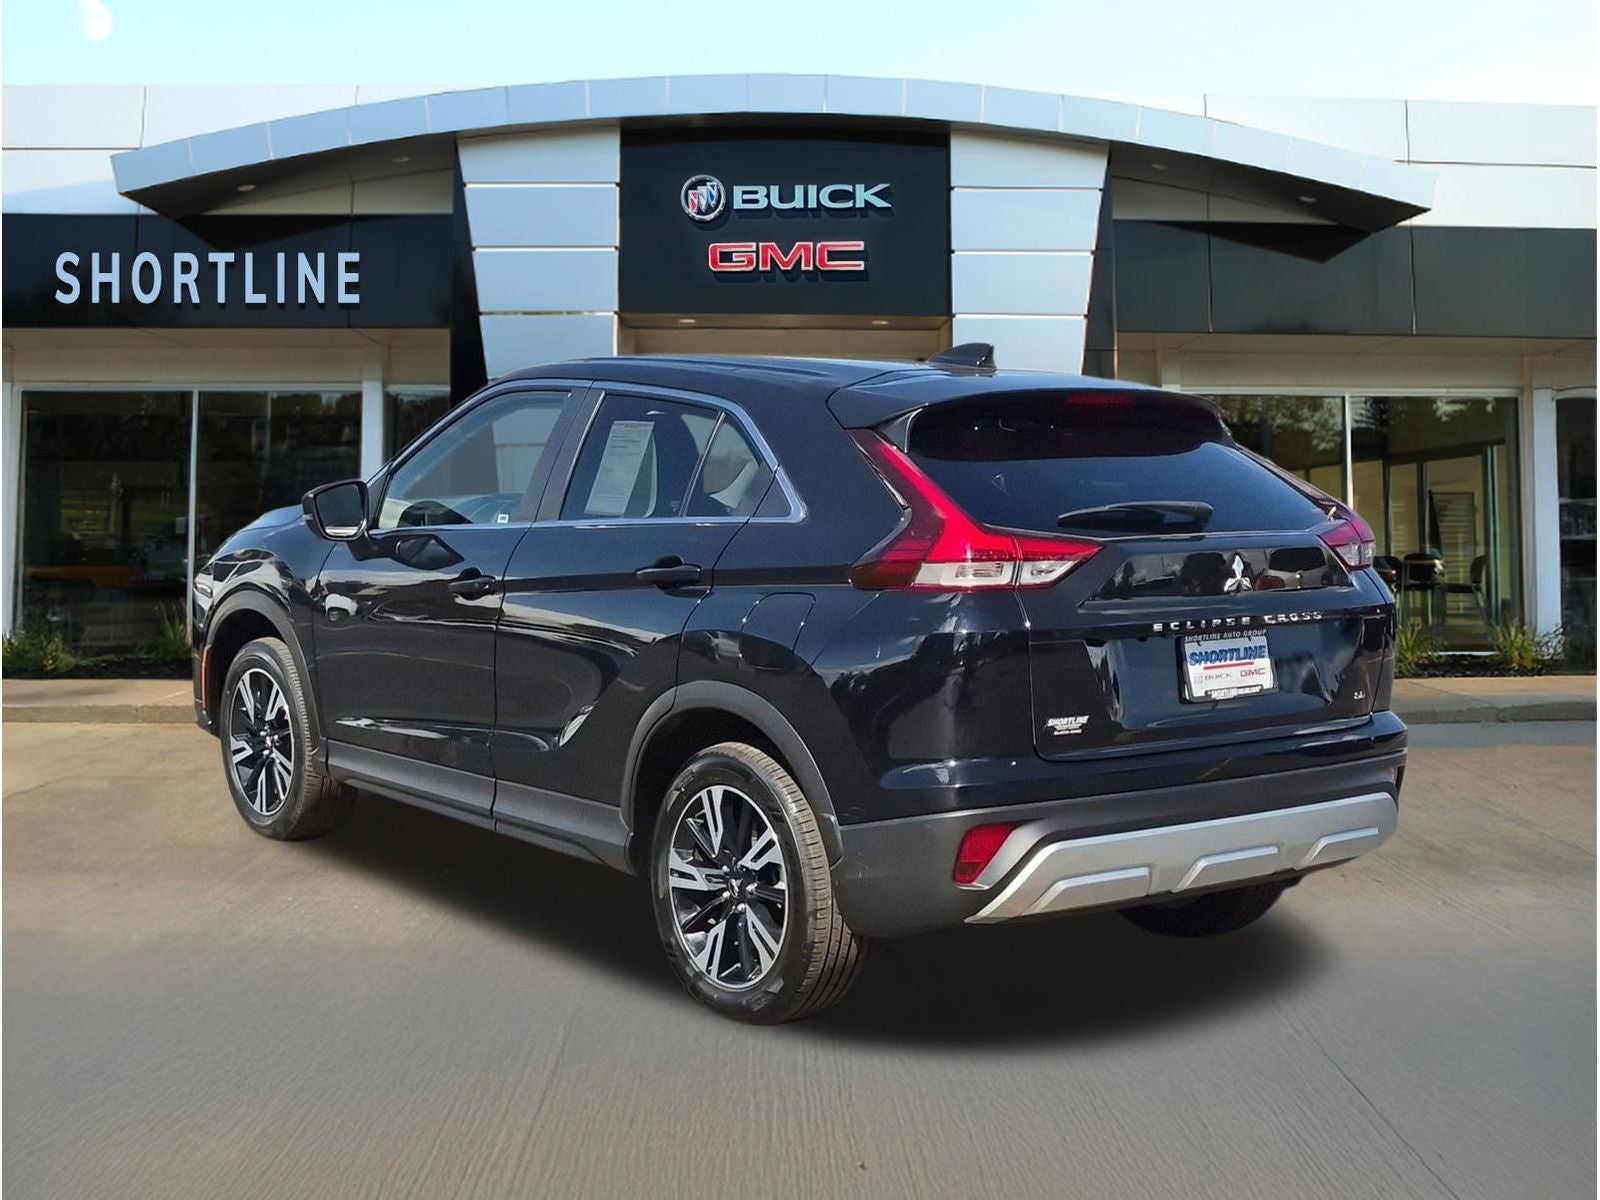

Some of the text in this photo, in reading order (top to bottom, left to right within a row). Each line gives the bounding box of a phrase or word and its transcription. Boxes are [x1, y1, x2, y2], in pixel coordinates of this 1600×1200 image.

[732, 182, 892, 210] BUICK
[708, 240, 865, 271] GMC
[54, 251, 360, 304] SHORTLINE
[1152, 611, 1323, 632] ECLIPSE CROSS
[1185, 629, 1267, 642] SHORTLINE AUTO GROUP
[1189, 645, 1266, 666] SHORTLINE
[1240, 667, 1266, 677] GMC
[1047, 715, 1089, 727] SHORTLINE
